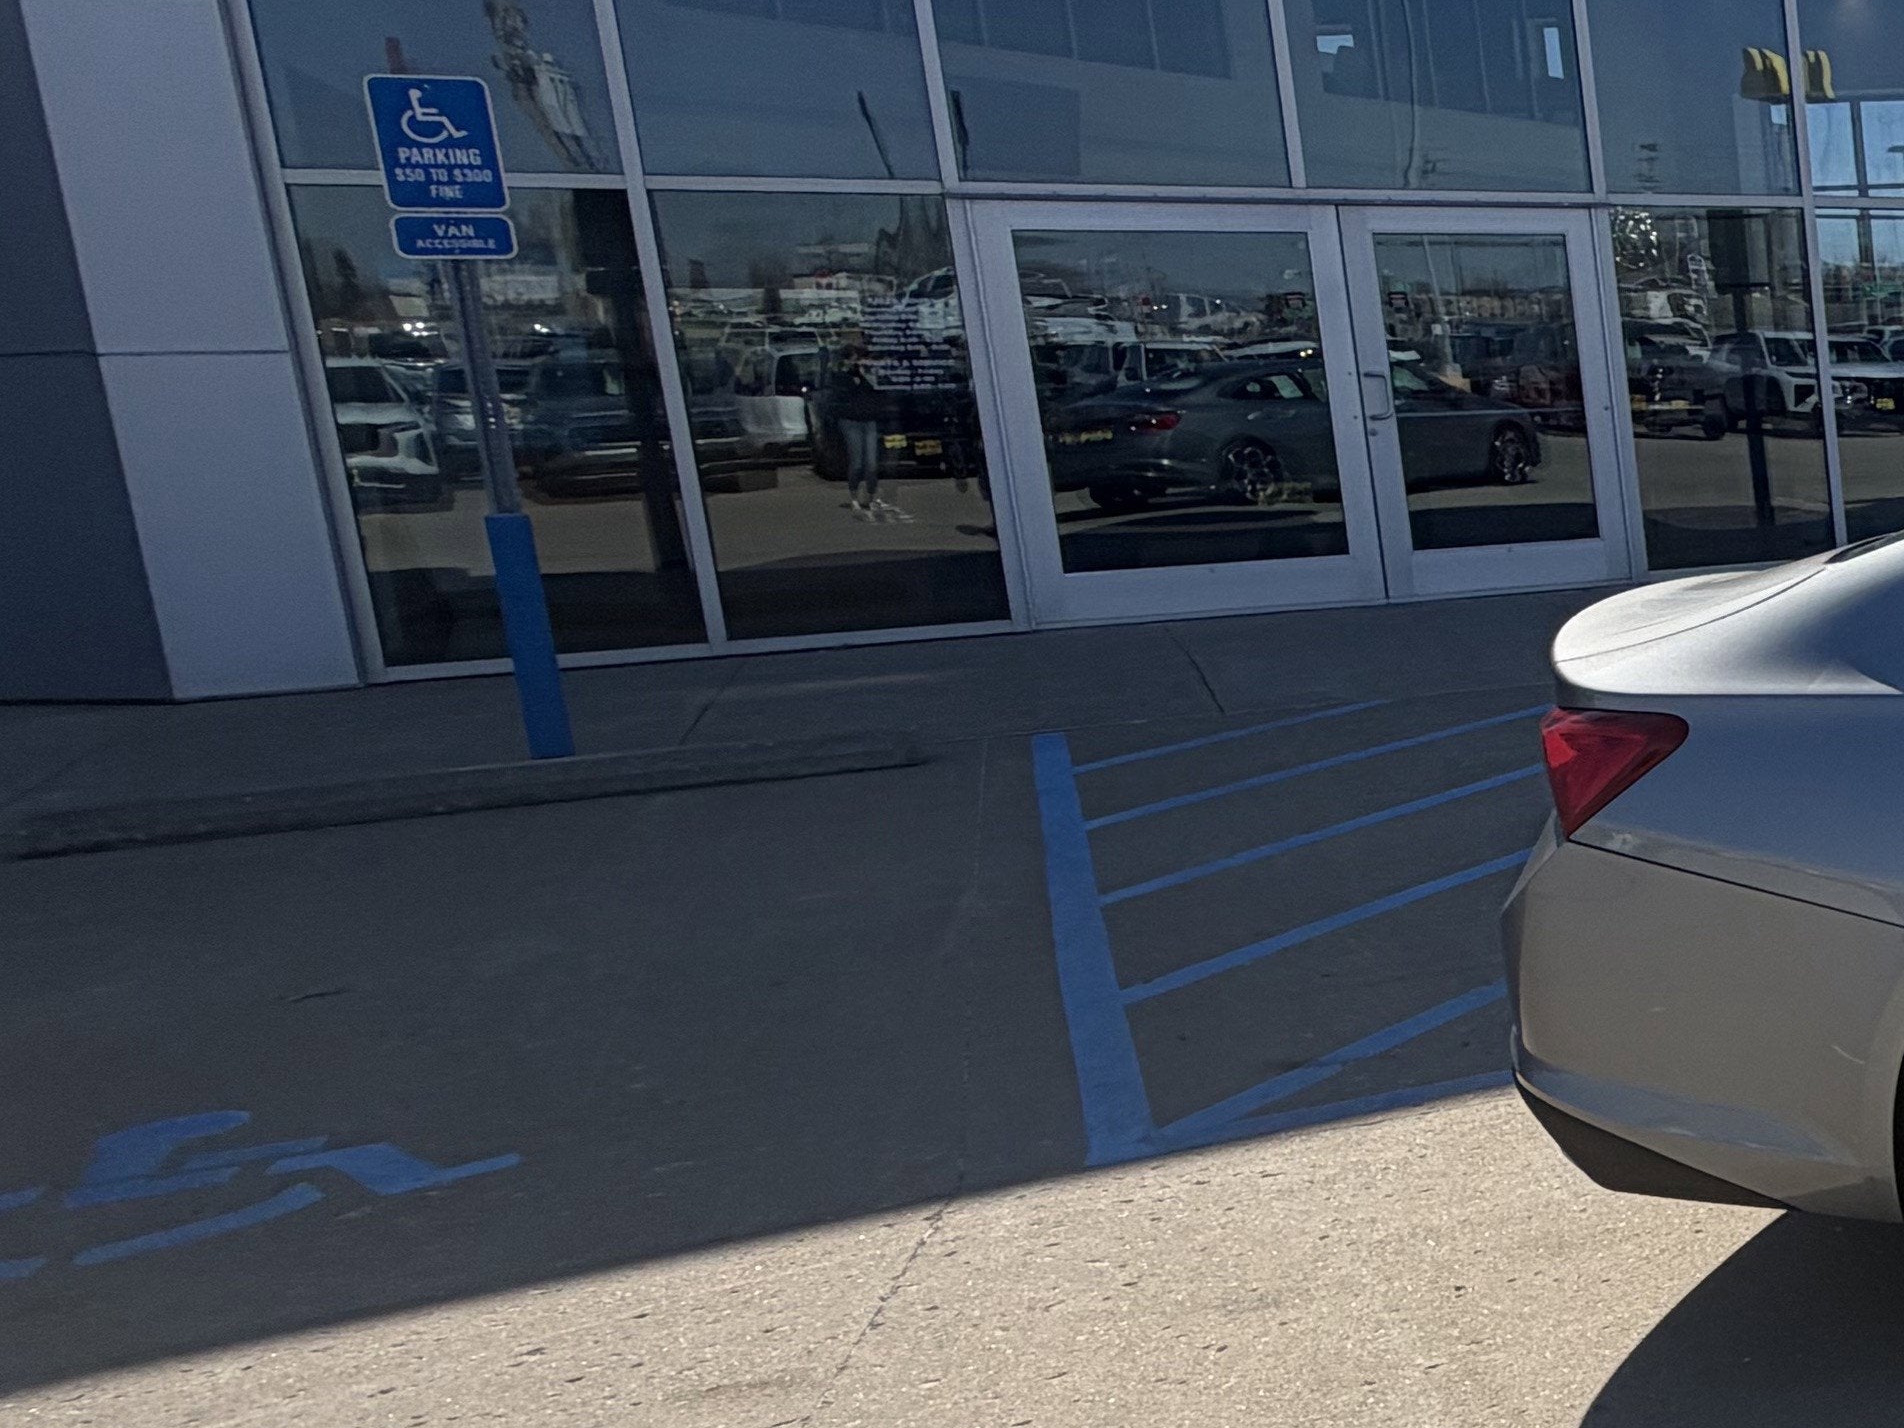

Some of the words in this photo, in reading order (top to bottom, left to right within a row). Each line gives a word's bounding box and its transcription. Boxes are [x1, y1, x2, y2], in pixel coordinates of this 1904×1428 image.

[397, 147, 482, 165] PARKING
[395, 167, 425, 182] $50
[429, 168, 448, 182] TO
[453, 168, 493, 183] $300
[429, 185, 464, 200] FINE
[433, 223, 476, 238] VAN
[416, 239, 497, 250] ACCESSIBLE
